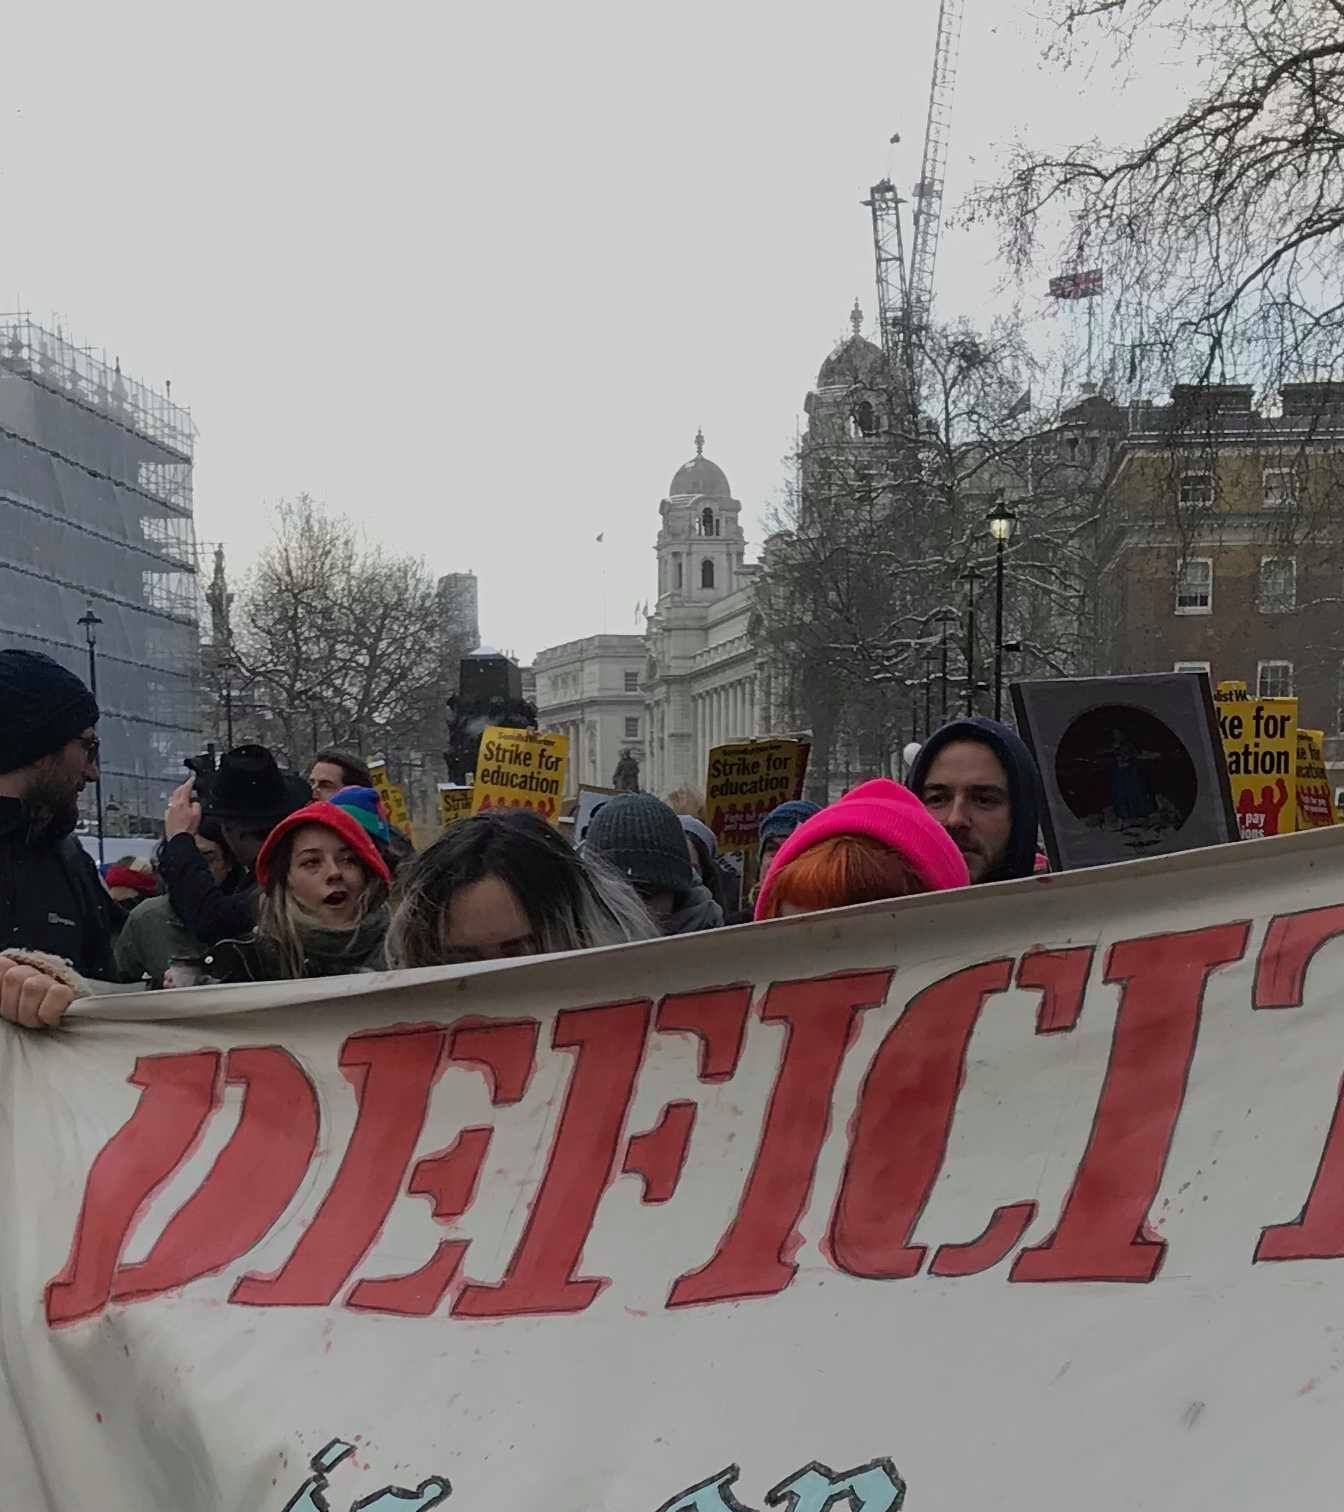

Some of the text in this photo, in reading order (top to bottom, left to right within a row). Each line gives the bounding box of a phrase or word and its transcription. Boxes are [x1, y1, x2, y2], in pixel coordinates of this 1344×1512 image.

[1253, 706, 1291, 739] for
[484, 740, 563, 772] Strike for
[711, 753, 792, 778] Strike for
[1228, 743, 1290, 775] ation
[480, 765, 560, 796] education
[709, 773, 790, 799] education
[443, 793, 473, 813] Strik
